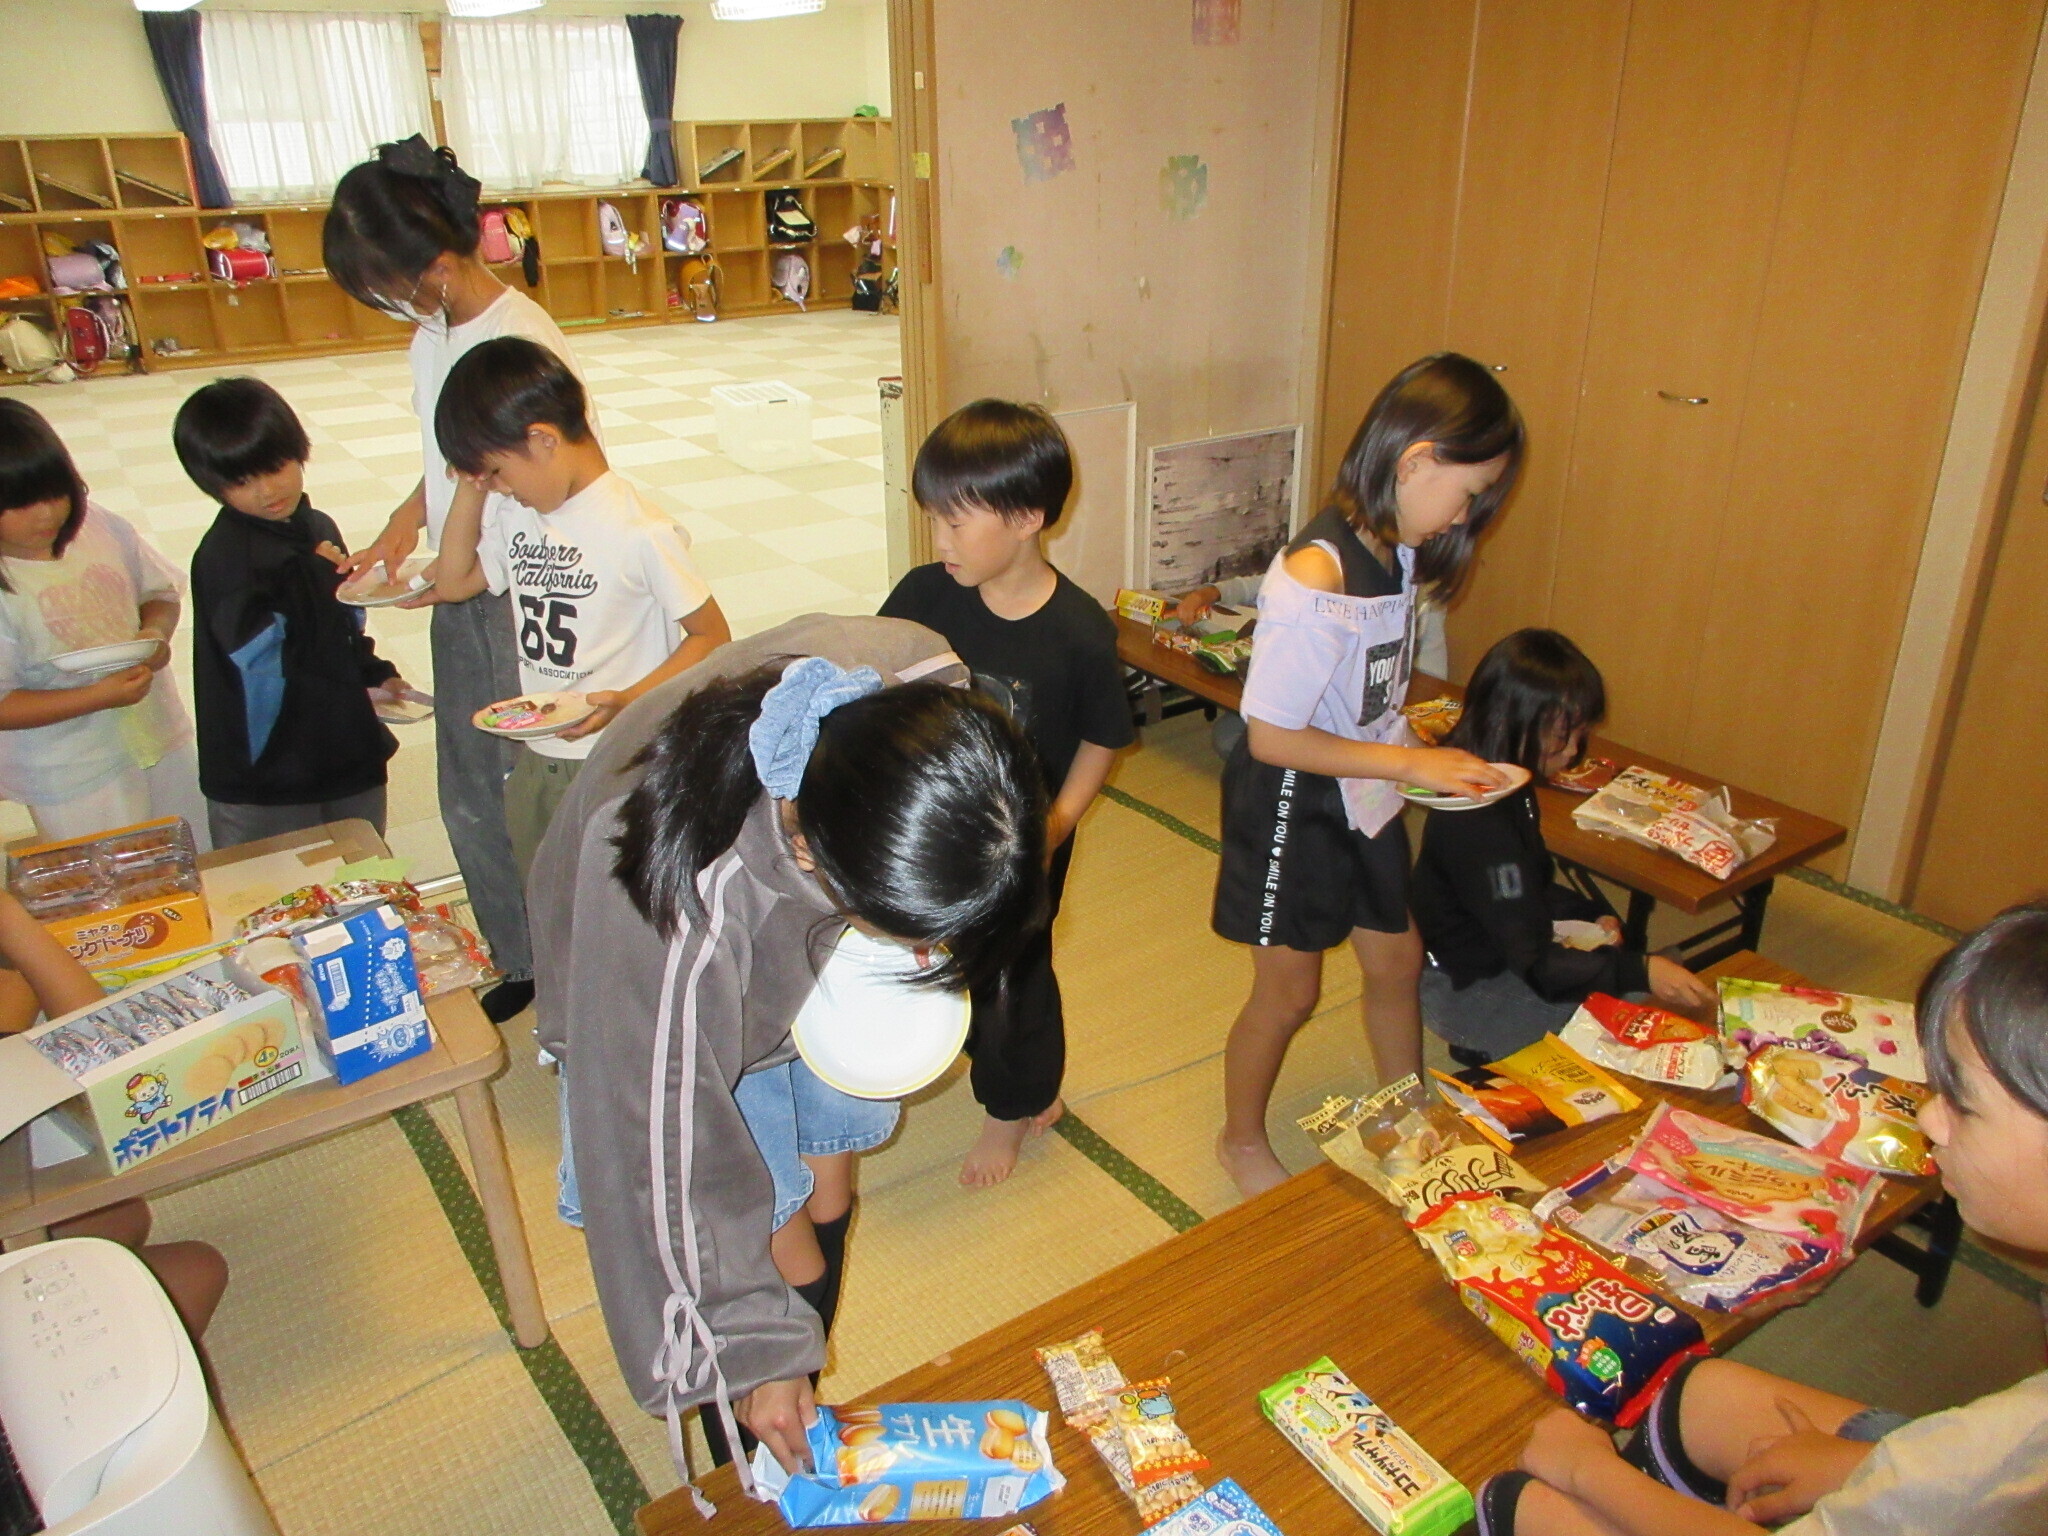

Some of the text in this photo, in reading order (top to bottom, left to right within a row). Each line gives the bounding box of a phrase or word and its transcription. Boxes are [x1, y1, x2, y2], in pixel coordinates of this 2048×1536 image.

[509, 531, 583, 566] Southern
[512, 559, 598, 592] California
[518, 594, 578, 668] 65
[1369, 657, 1396, 687] YOU
[1260, 768, 1296, 934] MILE ON YOU SMILE ON YOU
[68, 926, 149, 960] ングドーナツ
[76, 923, 121, 940] ミヤタの
[113, 1087, 237, 1169] ポテトフライ
[921, 1413, 976, 1449] 生
[1352, 1431, 1421, 1498] ココナッツサブレ
